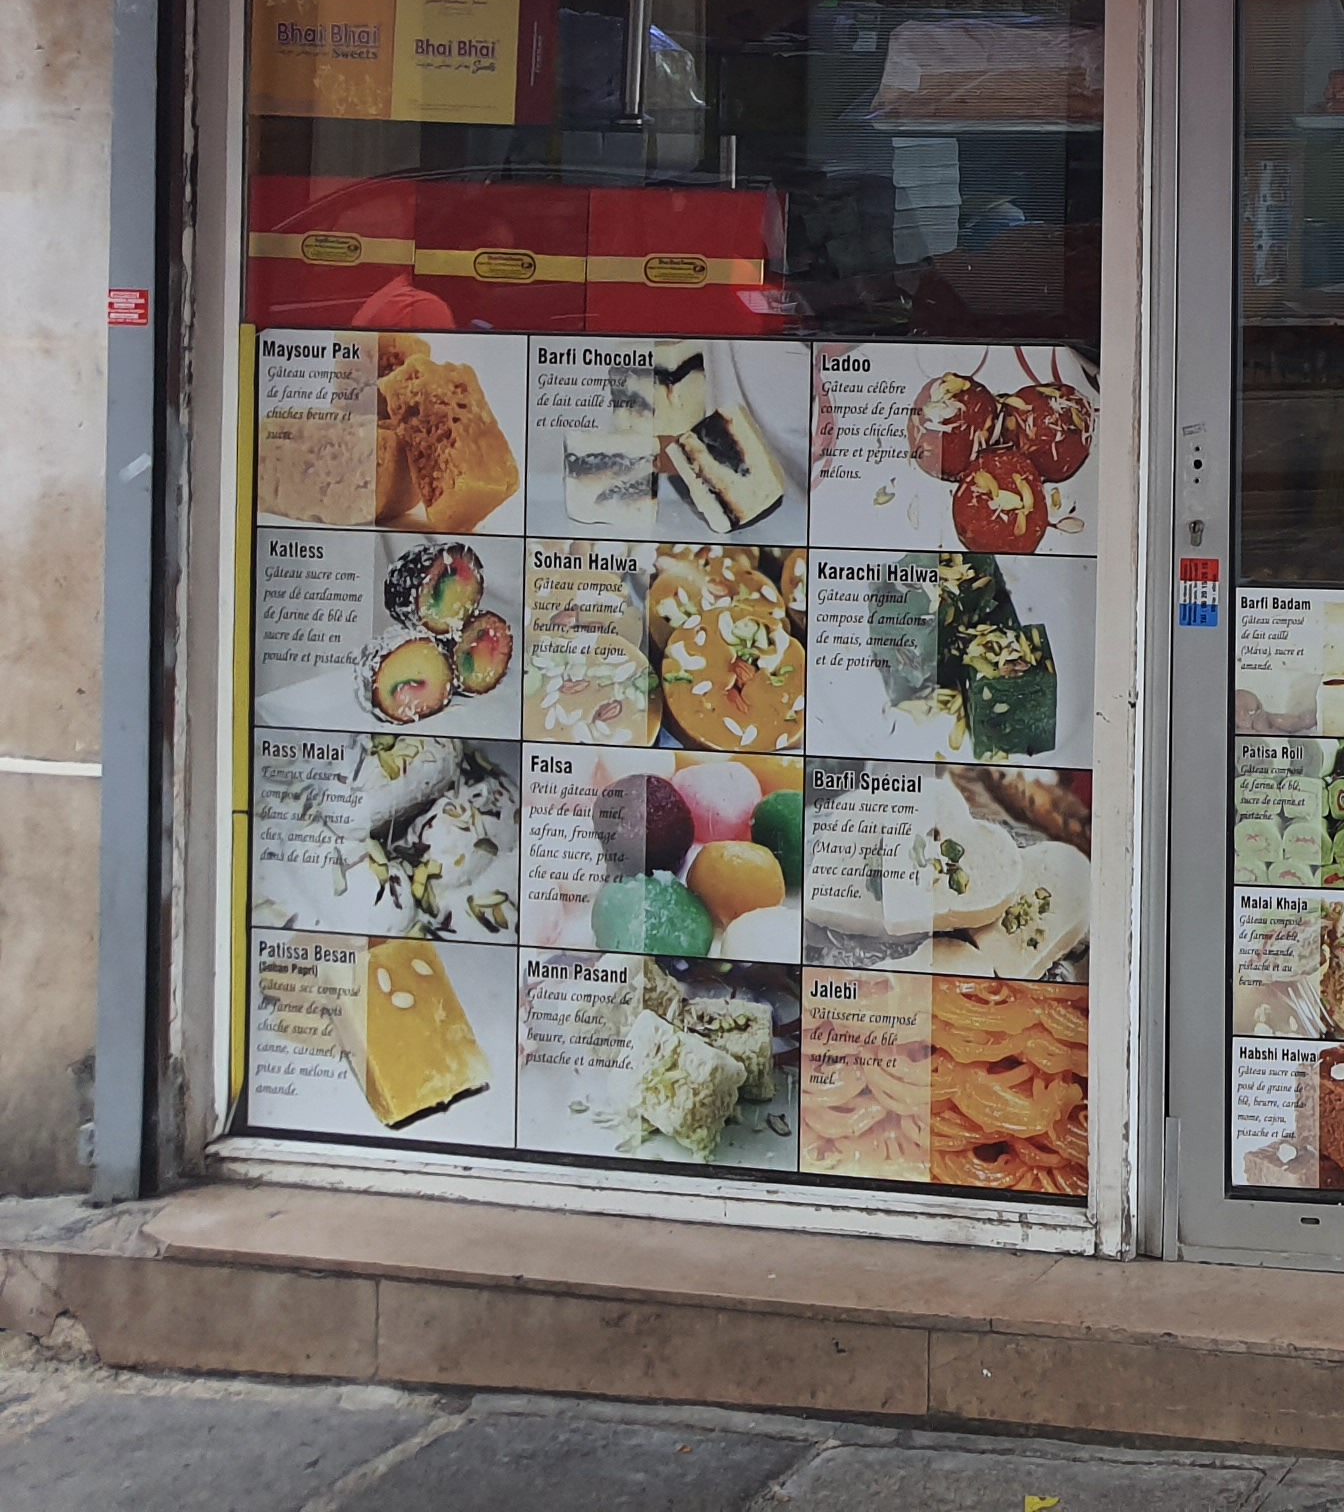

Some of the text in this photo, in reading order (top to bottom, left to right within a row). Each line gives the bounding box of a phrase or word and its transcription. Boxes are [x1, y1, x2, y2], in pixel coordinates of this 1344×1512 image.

[277, 22, 379, 45] Bhai Bhai
[415, 39, 496, 58] Bhai Bhai
[263, 341, 359, 361] Maysour Pak
[538, 348, 653, 366] Barfi Chocolat
[822, 355, 870, 372] Ladoo
[822, 381, 863, 396] Gâteau
[821, 402, 922, 419] composé de farine
[821, 422, 833, 434] de
[836, 424, 860, 439] pois
[821, 448, 849, 457] sucre
[853, 448, 863, 457] et
[911, 446, 924, 459] de
[270, 541, 323, 559] Katless
[534, 551, 636, 571] Sohan Halwa
[818, 562, 938, 583] Karachi Halwa
[818, 589, 911, 607] Gâteau original
[1241, 597, 1311, 610] Barfi Badam
[532, 641, 626, 660] pistache et cajou.
[816, 653, 891, 670] et de potiron.
[262, 741, 344, 760] Rass Malai
[1242, 746, 1303, 759] Patisa Roll
[531, 756, 572, 774] Falsa
[530, 782, 627, 799] Petit gâteau com-
[814, 771, 921, 794] Barfi Spécial
[557, 803, 569, 816] de
[814, 798, 855, 813] Gâteau
[892, 804, 919, 814] com-
[529, 824, 616, 843] safran, fromage
[812, 819, 912, 836] posé de lait caillé
[812, 840, 856, 858] (Mava)
[529, 865, 623, 883] che eau de rose et
[812, 864, 919, 880] avec cardamome et
[812, 884, 861, 900] pistache.
[1241, 896, 1308, 912] Malai Khaja
[259, 941, 355, 964] Patissa Besan
[528, 960, 627, 983] Mann Pasand
[527, 987, 567, 1000] Gâteau
[620, 991, 632, 1005] de
[811, 980, 857, 999] Jalebi
[524, 1009, 606, 1026] fromage blanc,
[811, 1008, 917, 1028] Pâtisserie composé
[570, 1032, 634, 1050] cardamome,
[810, 1029, 898, 1045] de farine de blé
[526, 1051, 633, 1070] pistache et amande.
[809, 1049, 897, 1067] safran, sucre et
[1239, 1047, 1316, 1062] Habshi Halwa
